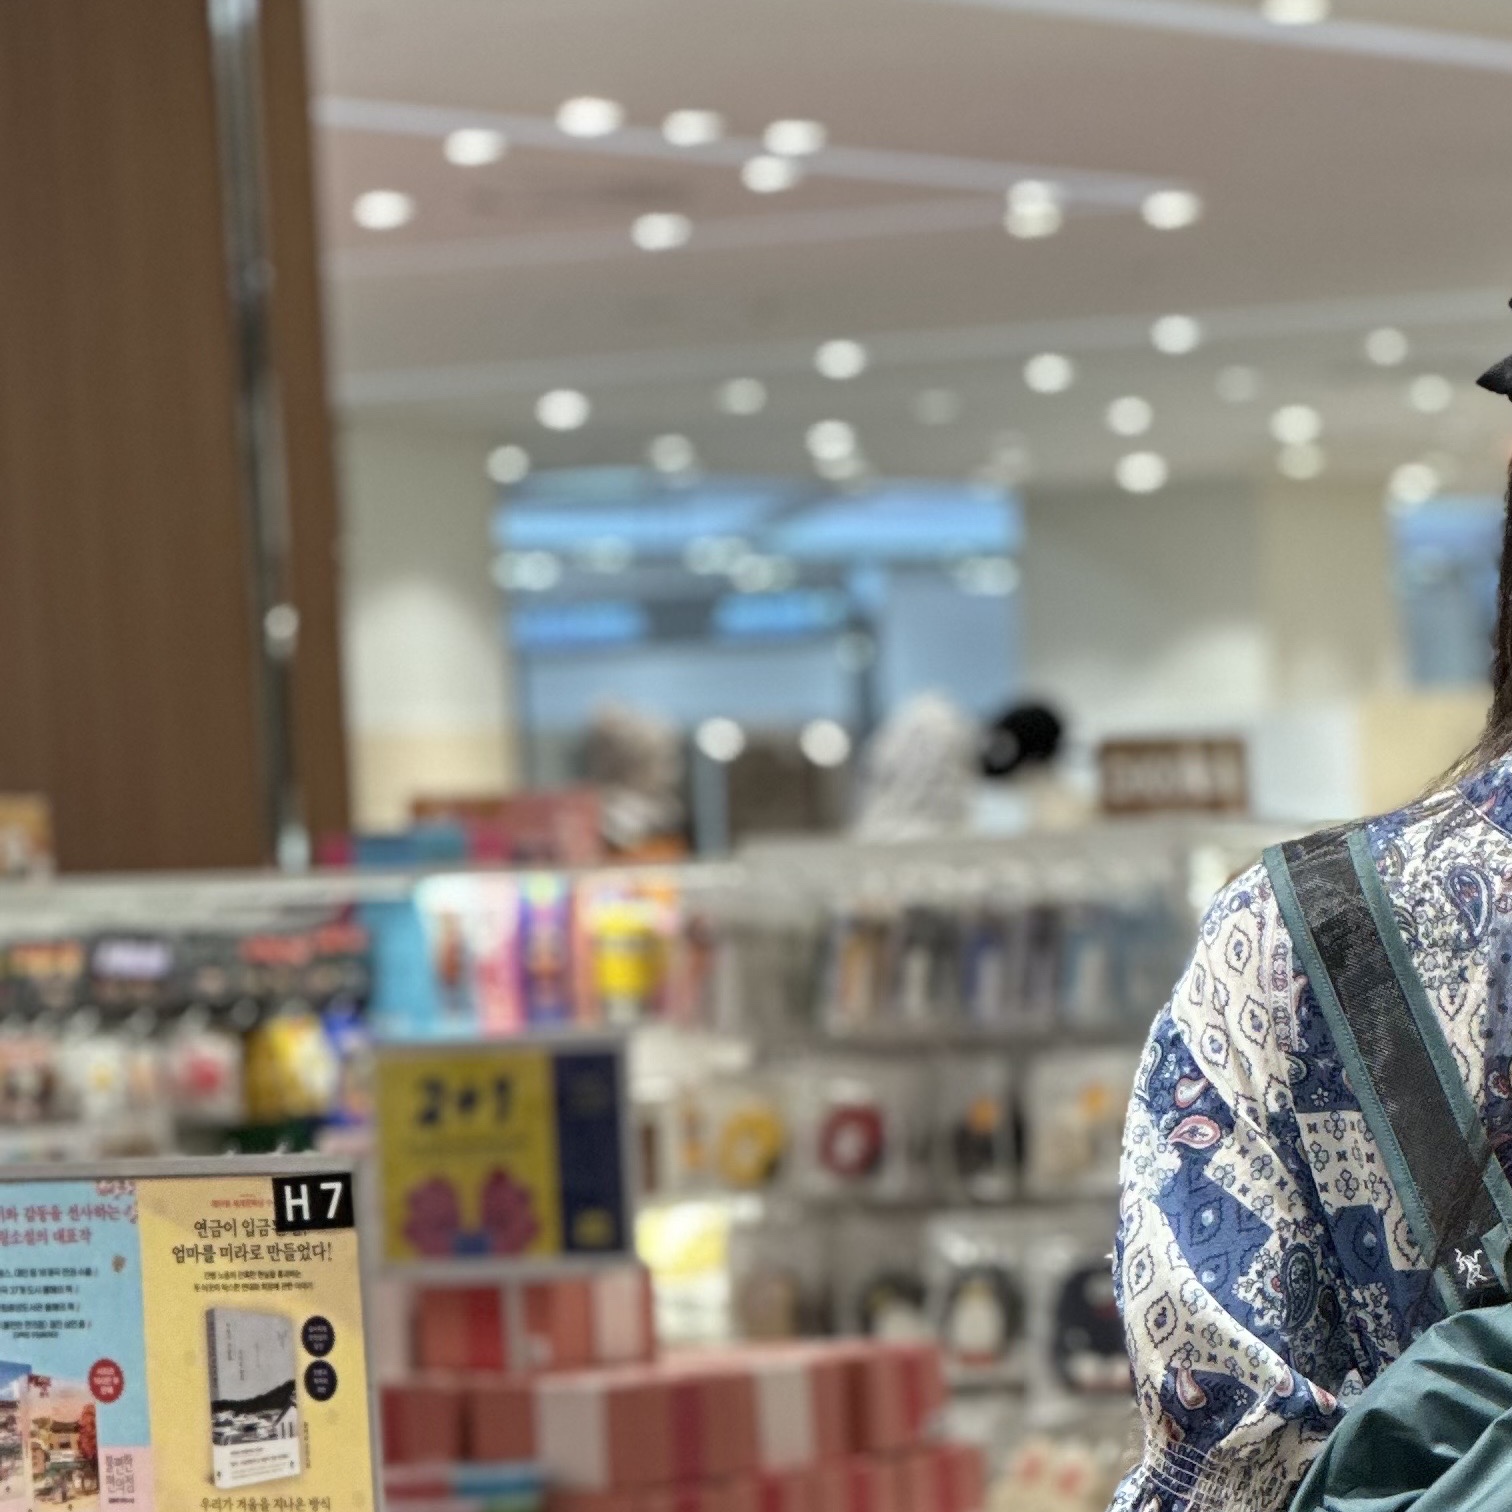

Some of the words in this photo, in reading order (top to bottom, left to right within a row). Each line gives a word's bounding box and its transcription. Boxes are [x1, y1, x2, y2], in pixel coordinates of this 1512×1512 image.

[194, 1218, 237, 1239] 연금이
[172, 1244, 216, 1264] 엄마를
[219, 1243, 264, 1262] 미라로
[266, 1241, 333, 1262] 만들었다!
